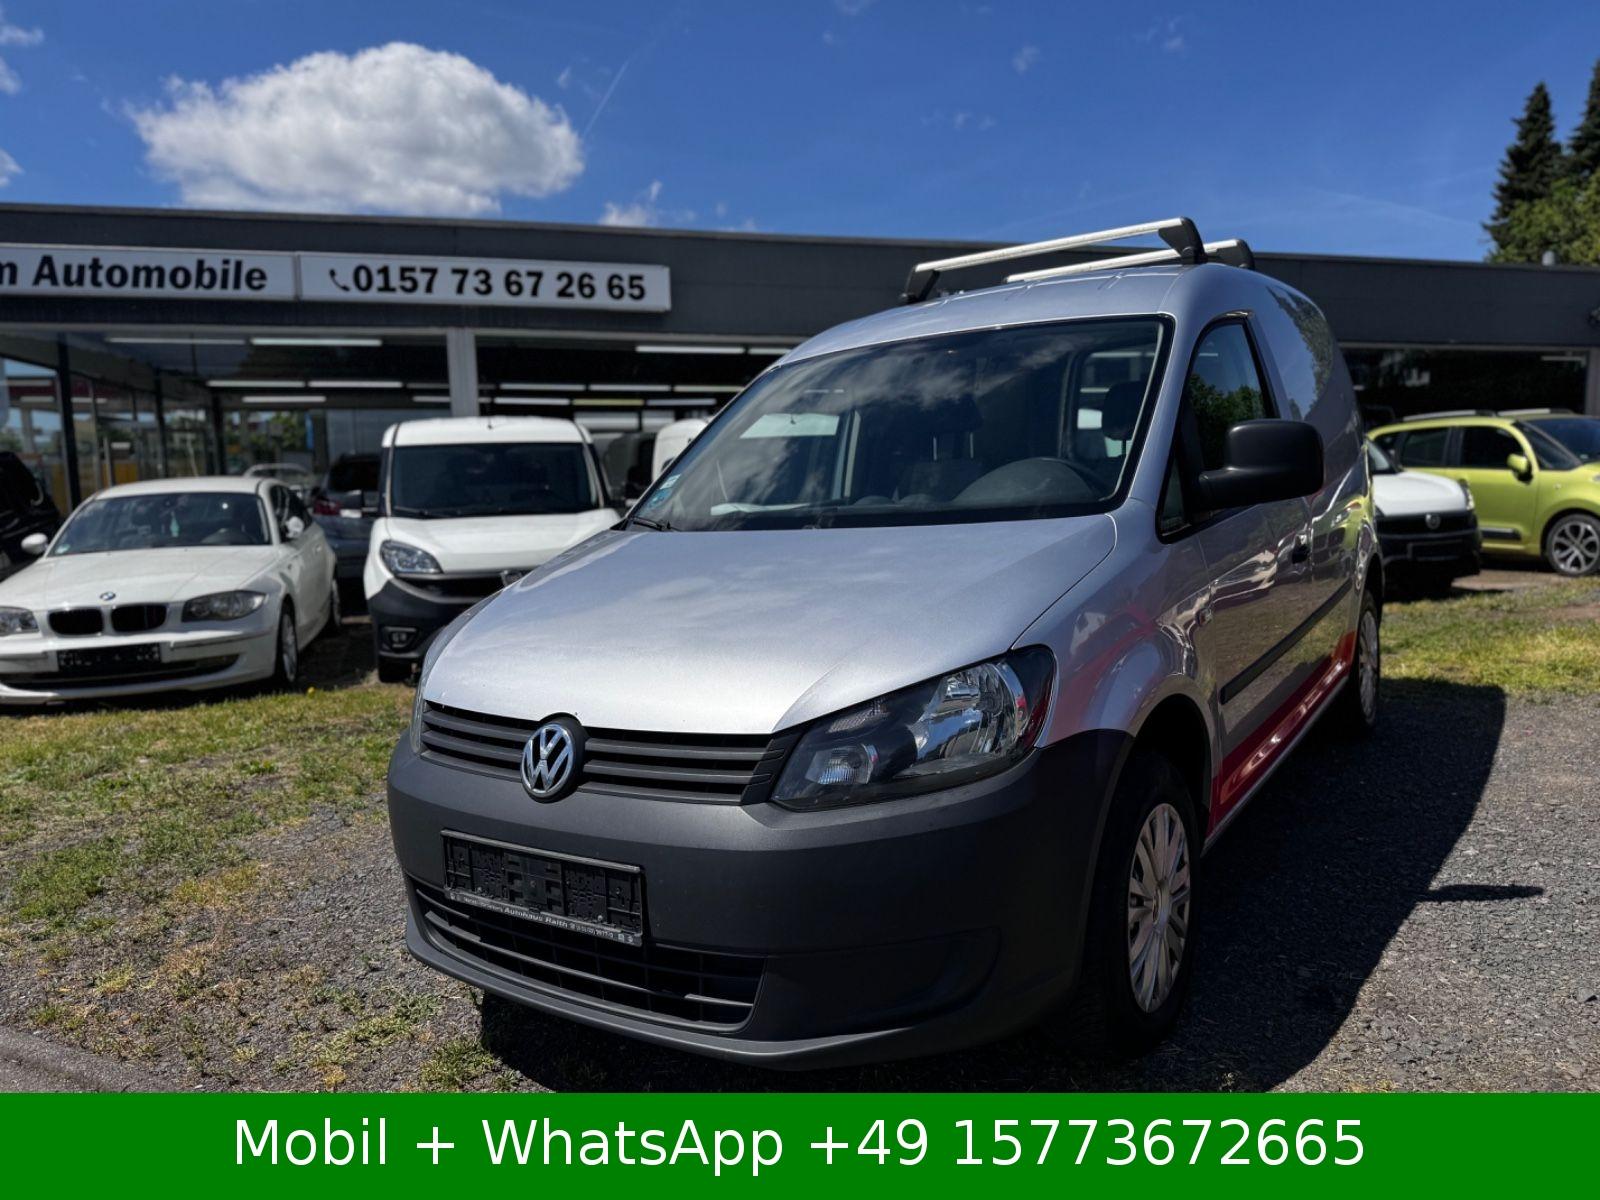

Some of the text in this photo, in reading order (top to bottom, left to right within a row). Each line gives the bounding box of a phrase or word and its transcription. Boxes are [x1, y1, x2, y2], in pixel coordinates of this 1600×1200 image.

[32, 254, 267, 291] Automobile
[353, 264, 646, 301] 0157 73 67 26 65
